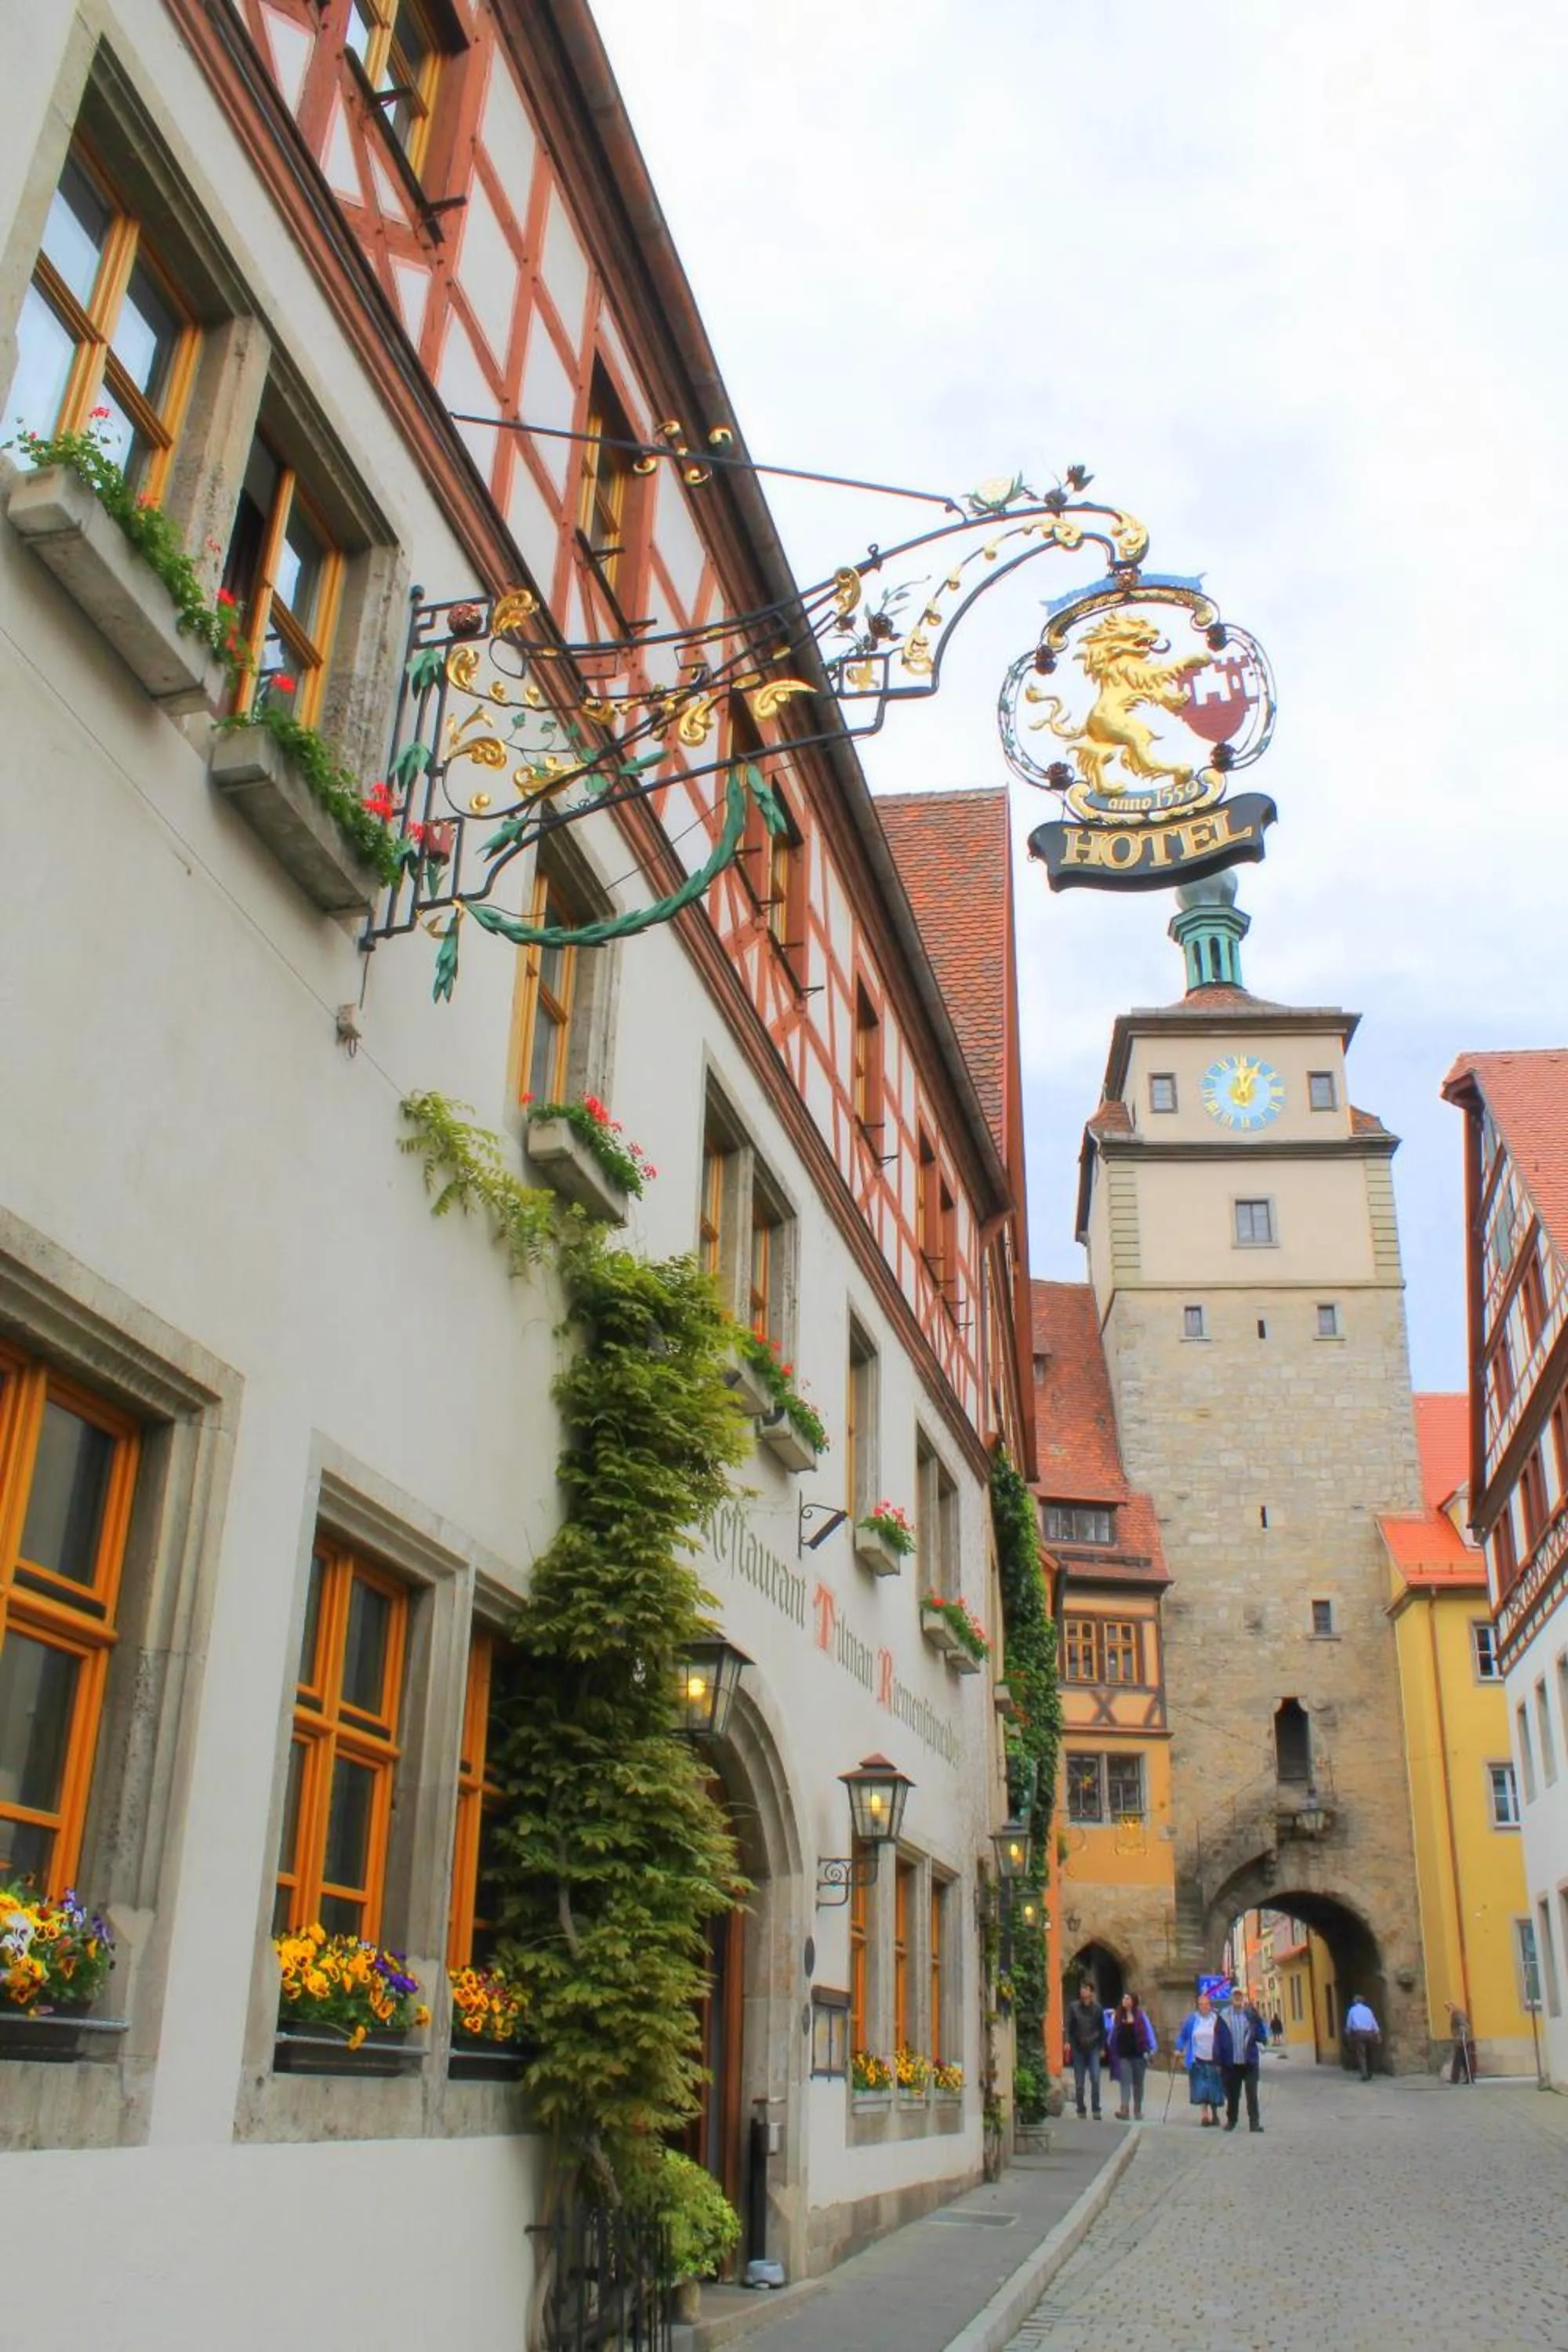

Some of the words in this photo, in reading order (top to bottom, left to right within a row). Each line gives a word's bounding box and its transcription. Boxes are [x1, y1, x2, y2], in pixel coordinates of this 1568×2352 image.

[1108, 797, 1152, 811] anno
[1155, 780, 1200, 808] 1559
[1062, 811, 1252, 869] HOTEL
[712, 1501, 807, 1631] estaurant
